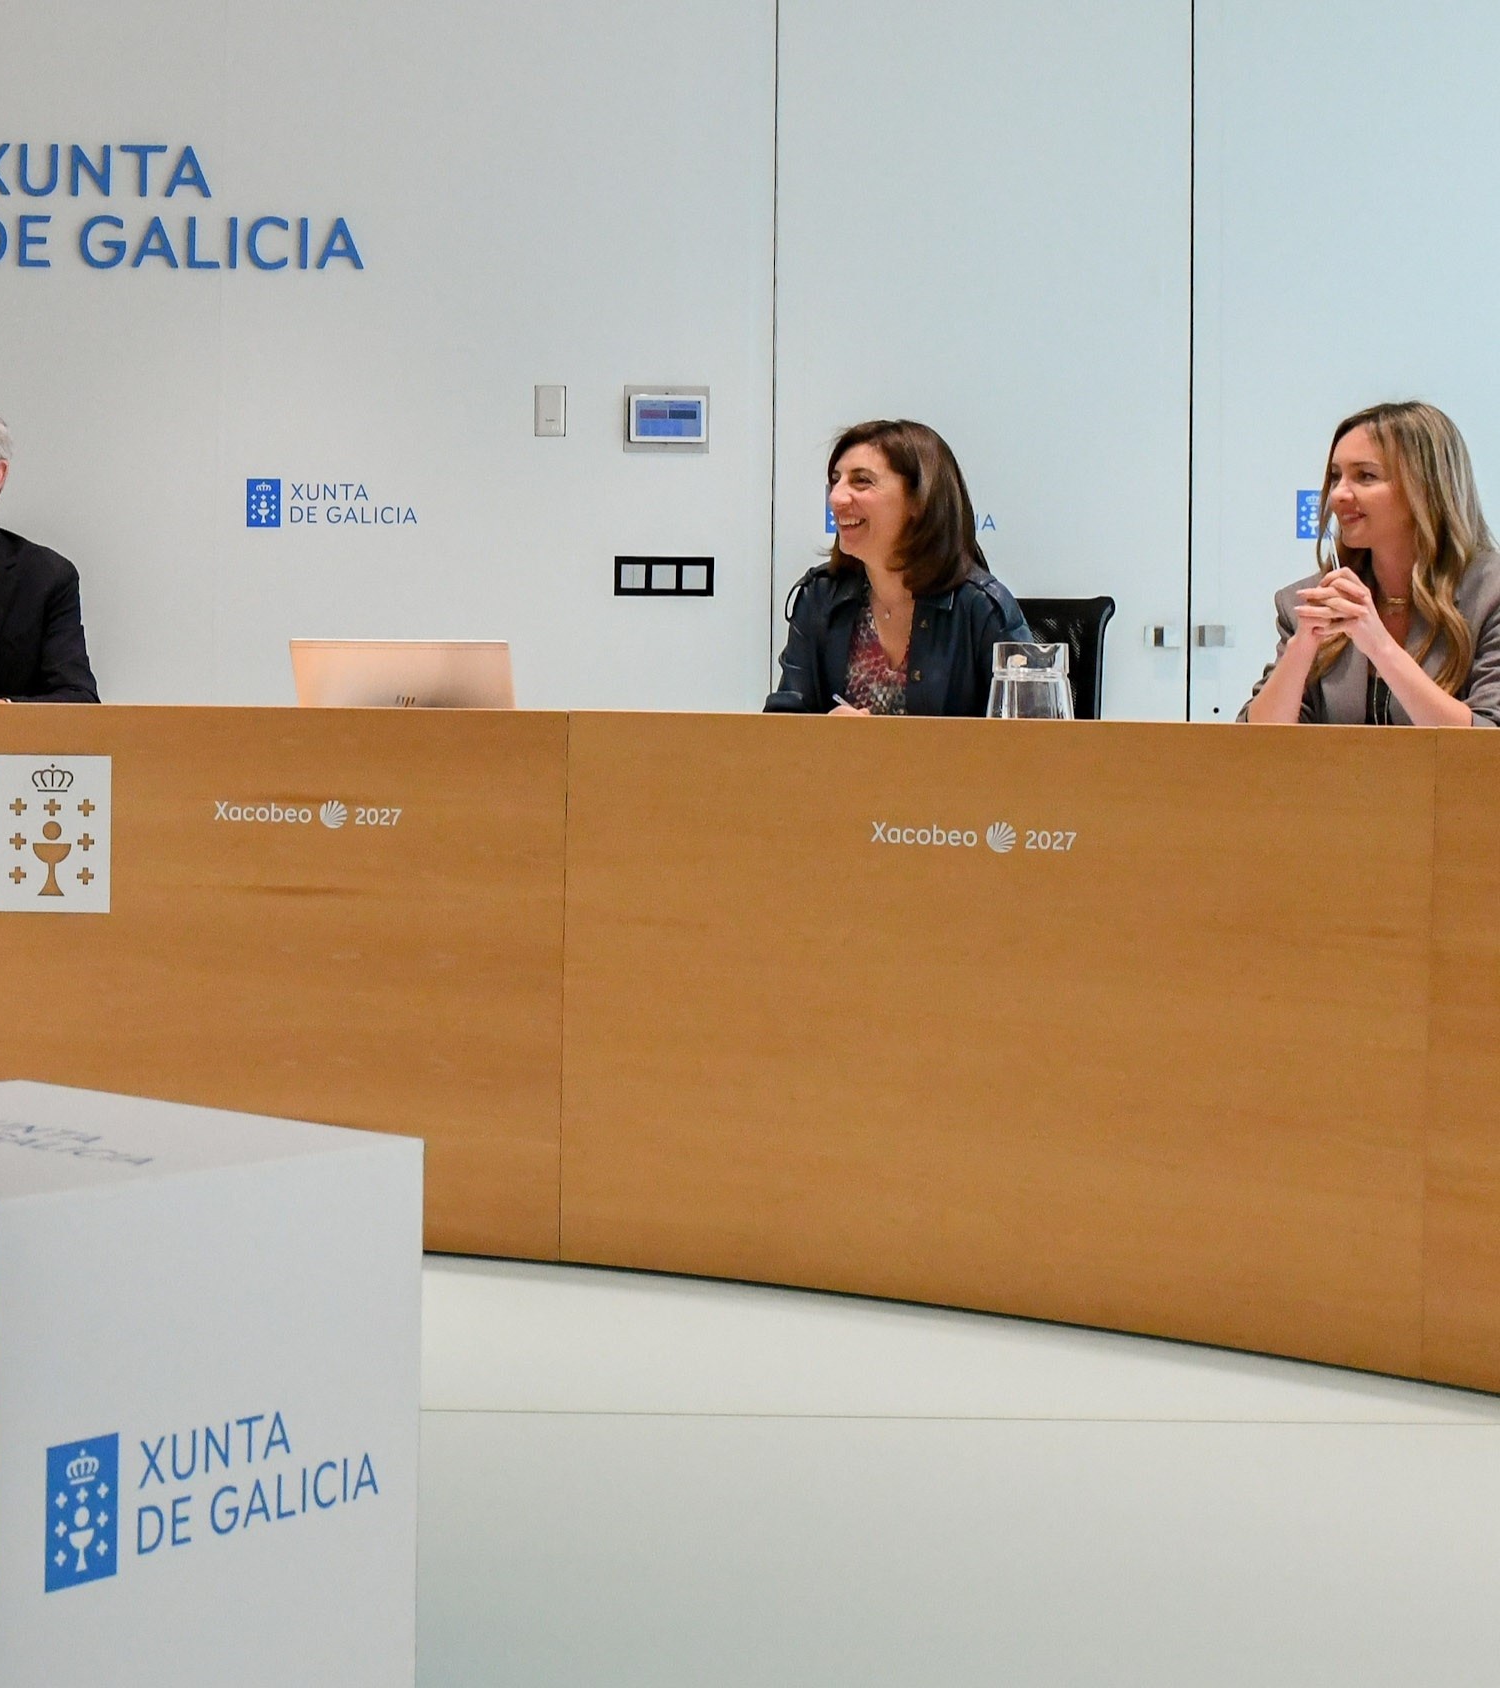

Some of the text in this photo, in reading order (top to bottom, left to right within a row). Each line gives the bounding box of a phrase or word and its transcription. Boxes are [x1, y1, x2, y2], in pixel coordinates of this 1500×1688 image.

[79, 215, 364, 270] GALICIA
[291, 483, 369, 501] XUNTA
[290, 506, 417, 524] DE GALICIA
[214, 800, 402, 826] Xacobeo 2027
[871, 821, 1077, 850] Xacobeo 2027
[138, 1411, 291, 1489] XUNTA
[137, 1452, 379, 1555] DE GALICIA
